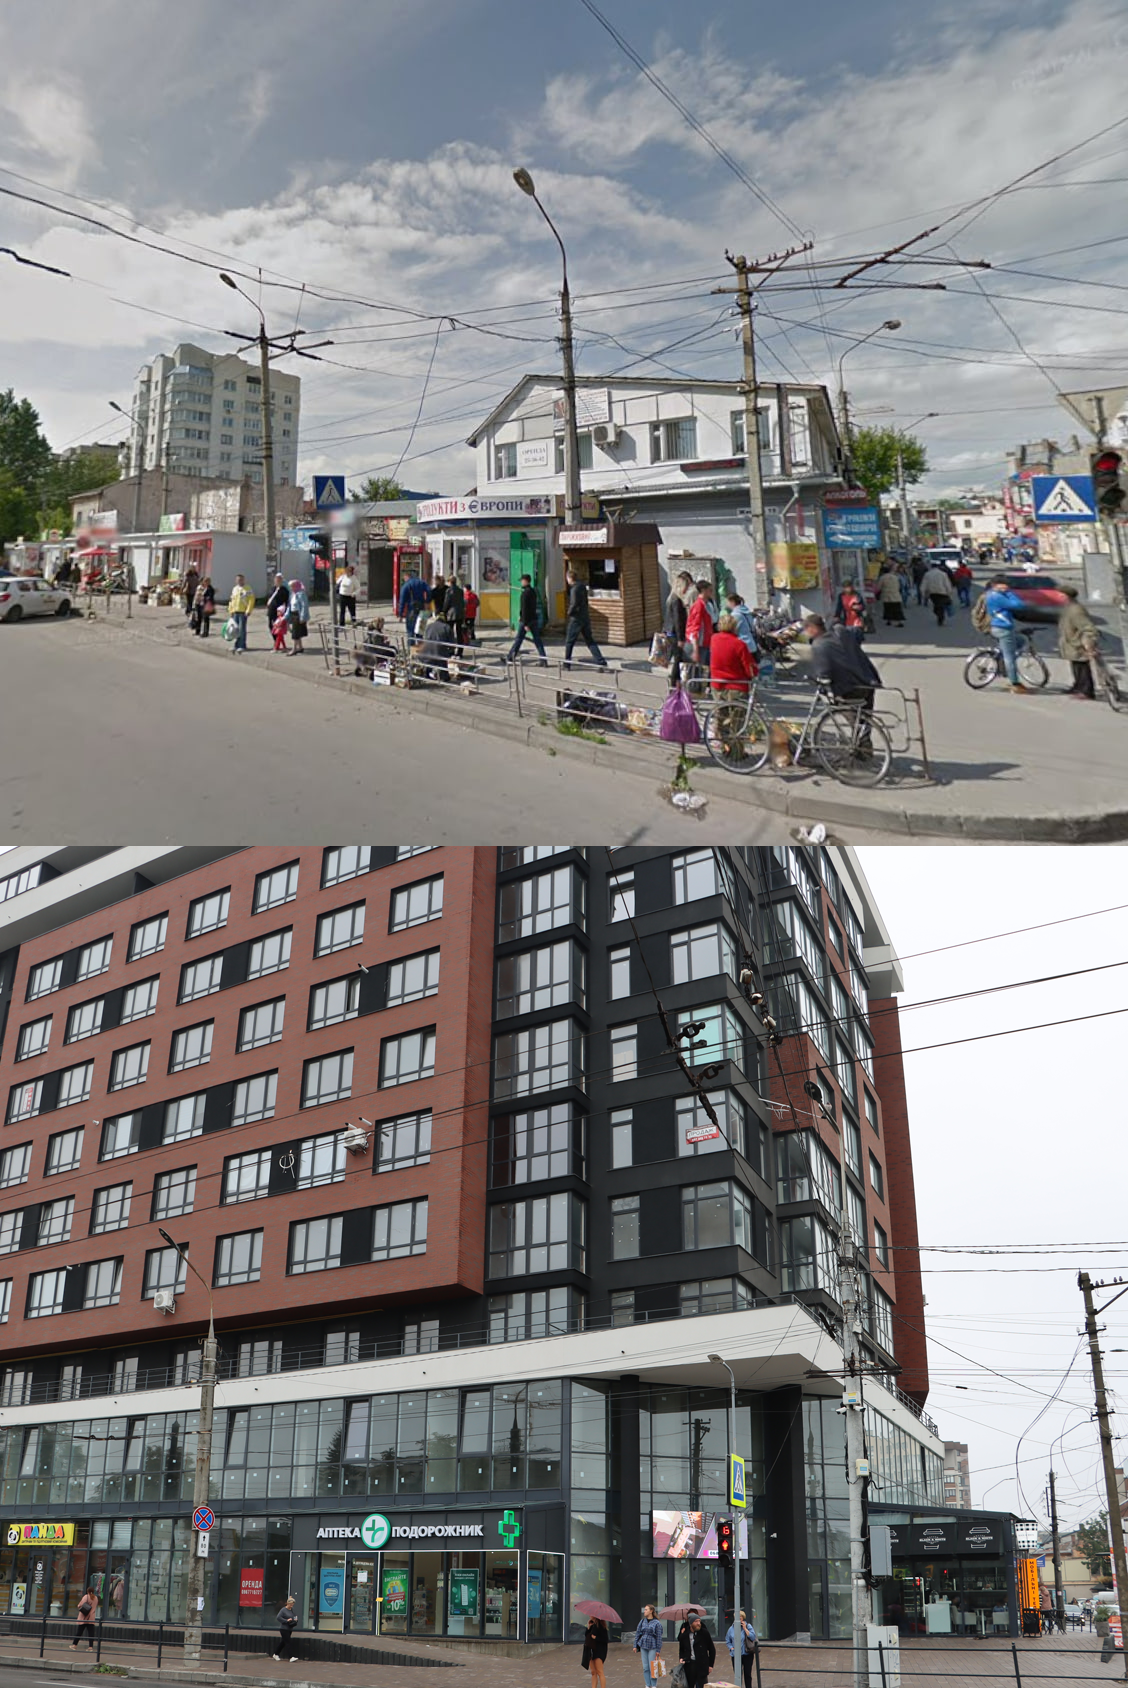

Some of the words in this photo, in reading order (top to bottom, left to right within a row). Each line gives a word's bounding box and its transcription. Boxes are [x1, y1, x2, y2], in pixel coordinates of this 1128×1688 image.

[422, 500, 458, 518] ПРОДУКТИ
[23, 1525, 64, 1538] ПАНДА
[316, 1527, 362, 1538] АПТЕКА
[391, 1525, 484, 1539] ПОДОРОЖНИК
[241, 1580, 262, 1589] ОРЕНДА
